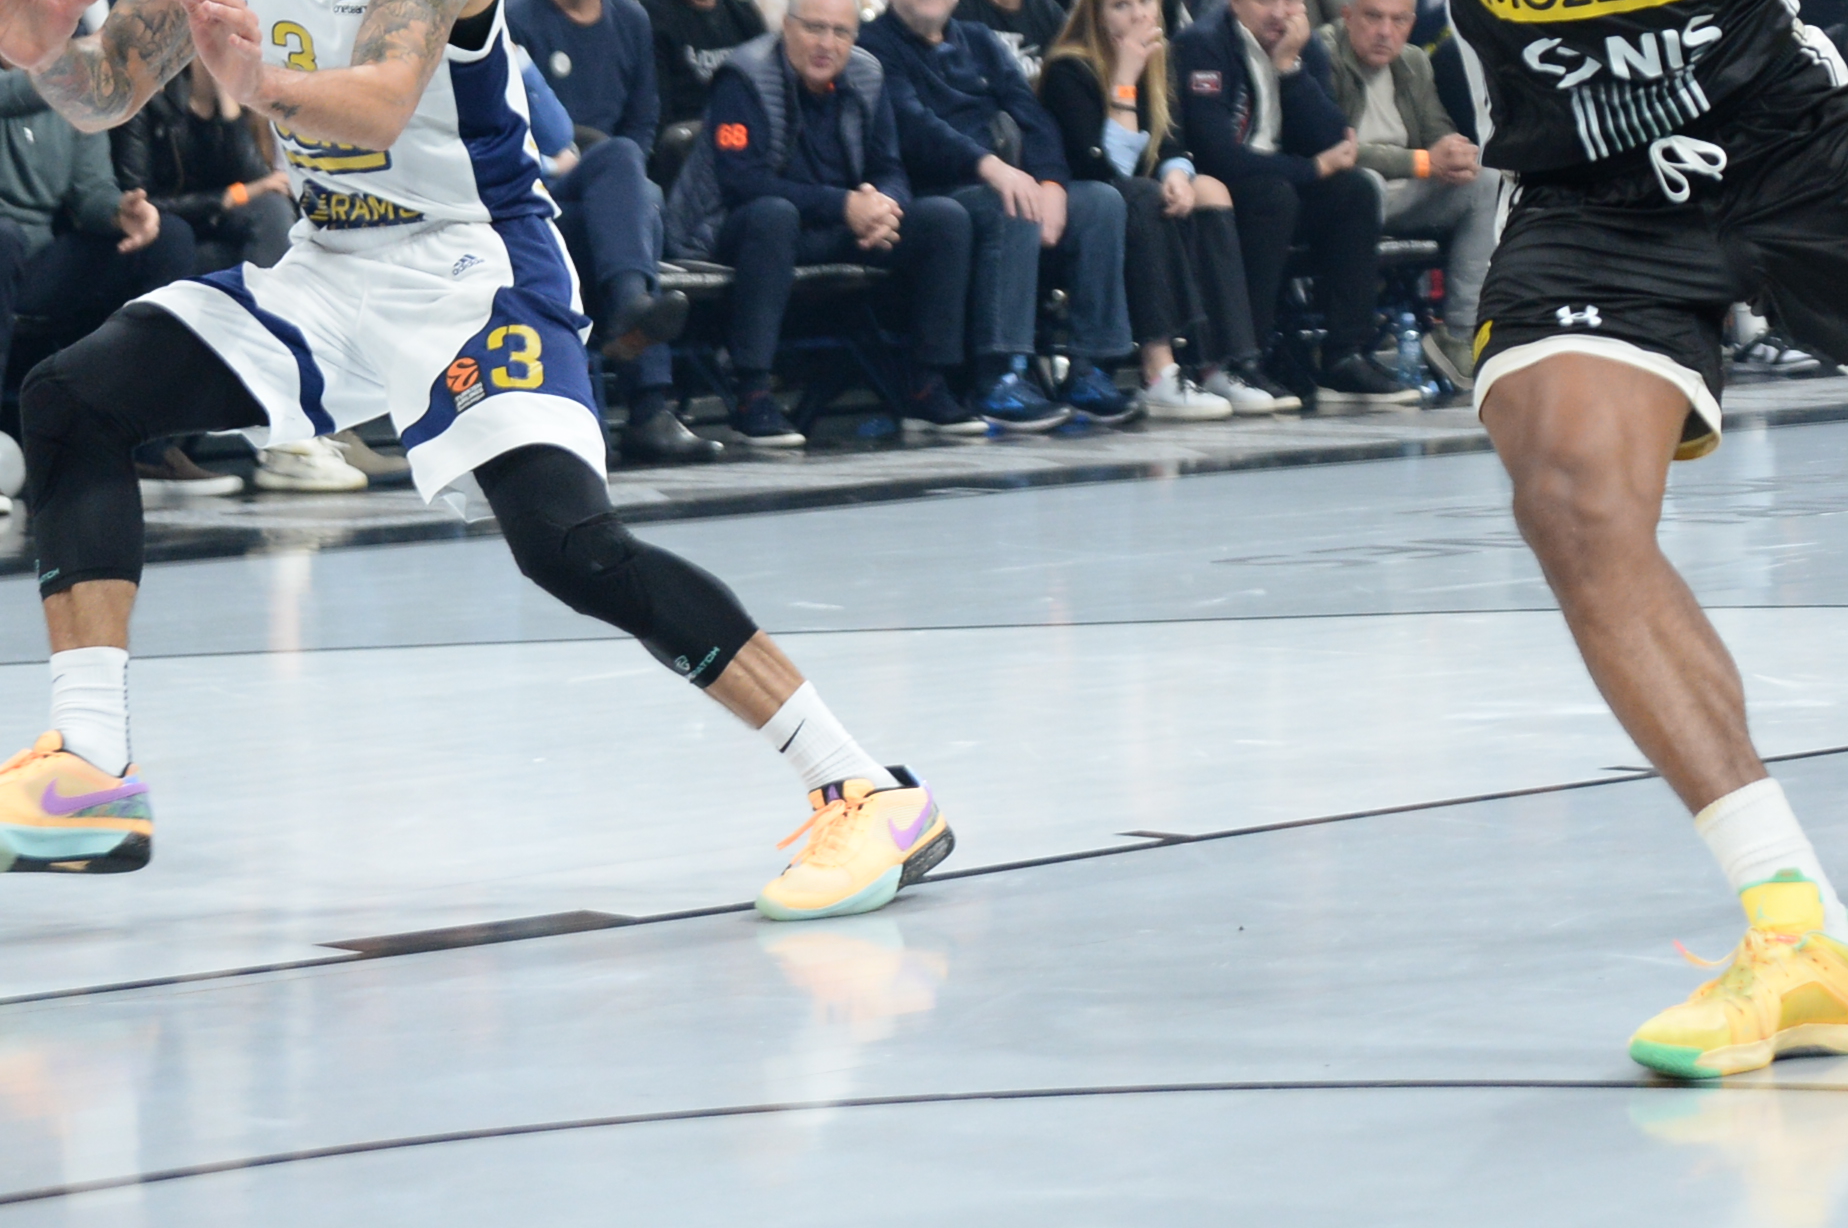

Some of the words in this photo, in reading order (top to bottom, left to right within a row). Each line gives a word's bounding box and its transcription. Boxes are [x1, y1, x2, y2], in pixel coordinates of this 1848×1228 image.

[1605, 13, 1723, 80] NIS
[716, 122, 749, 150] 68
[486, 323, 544, 389] 3
